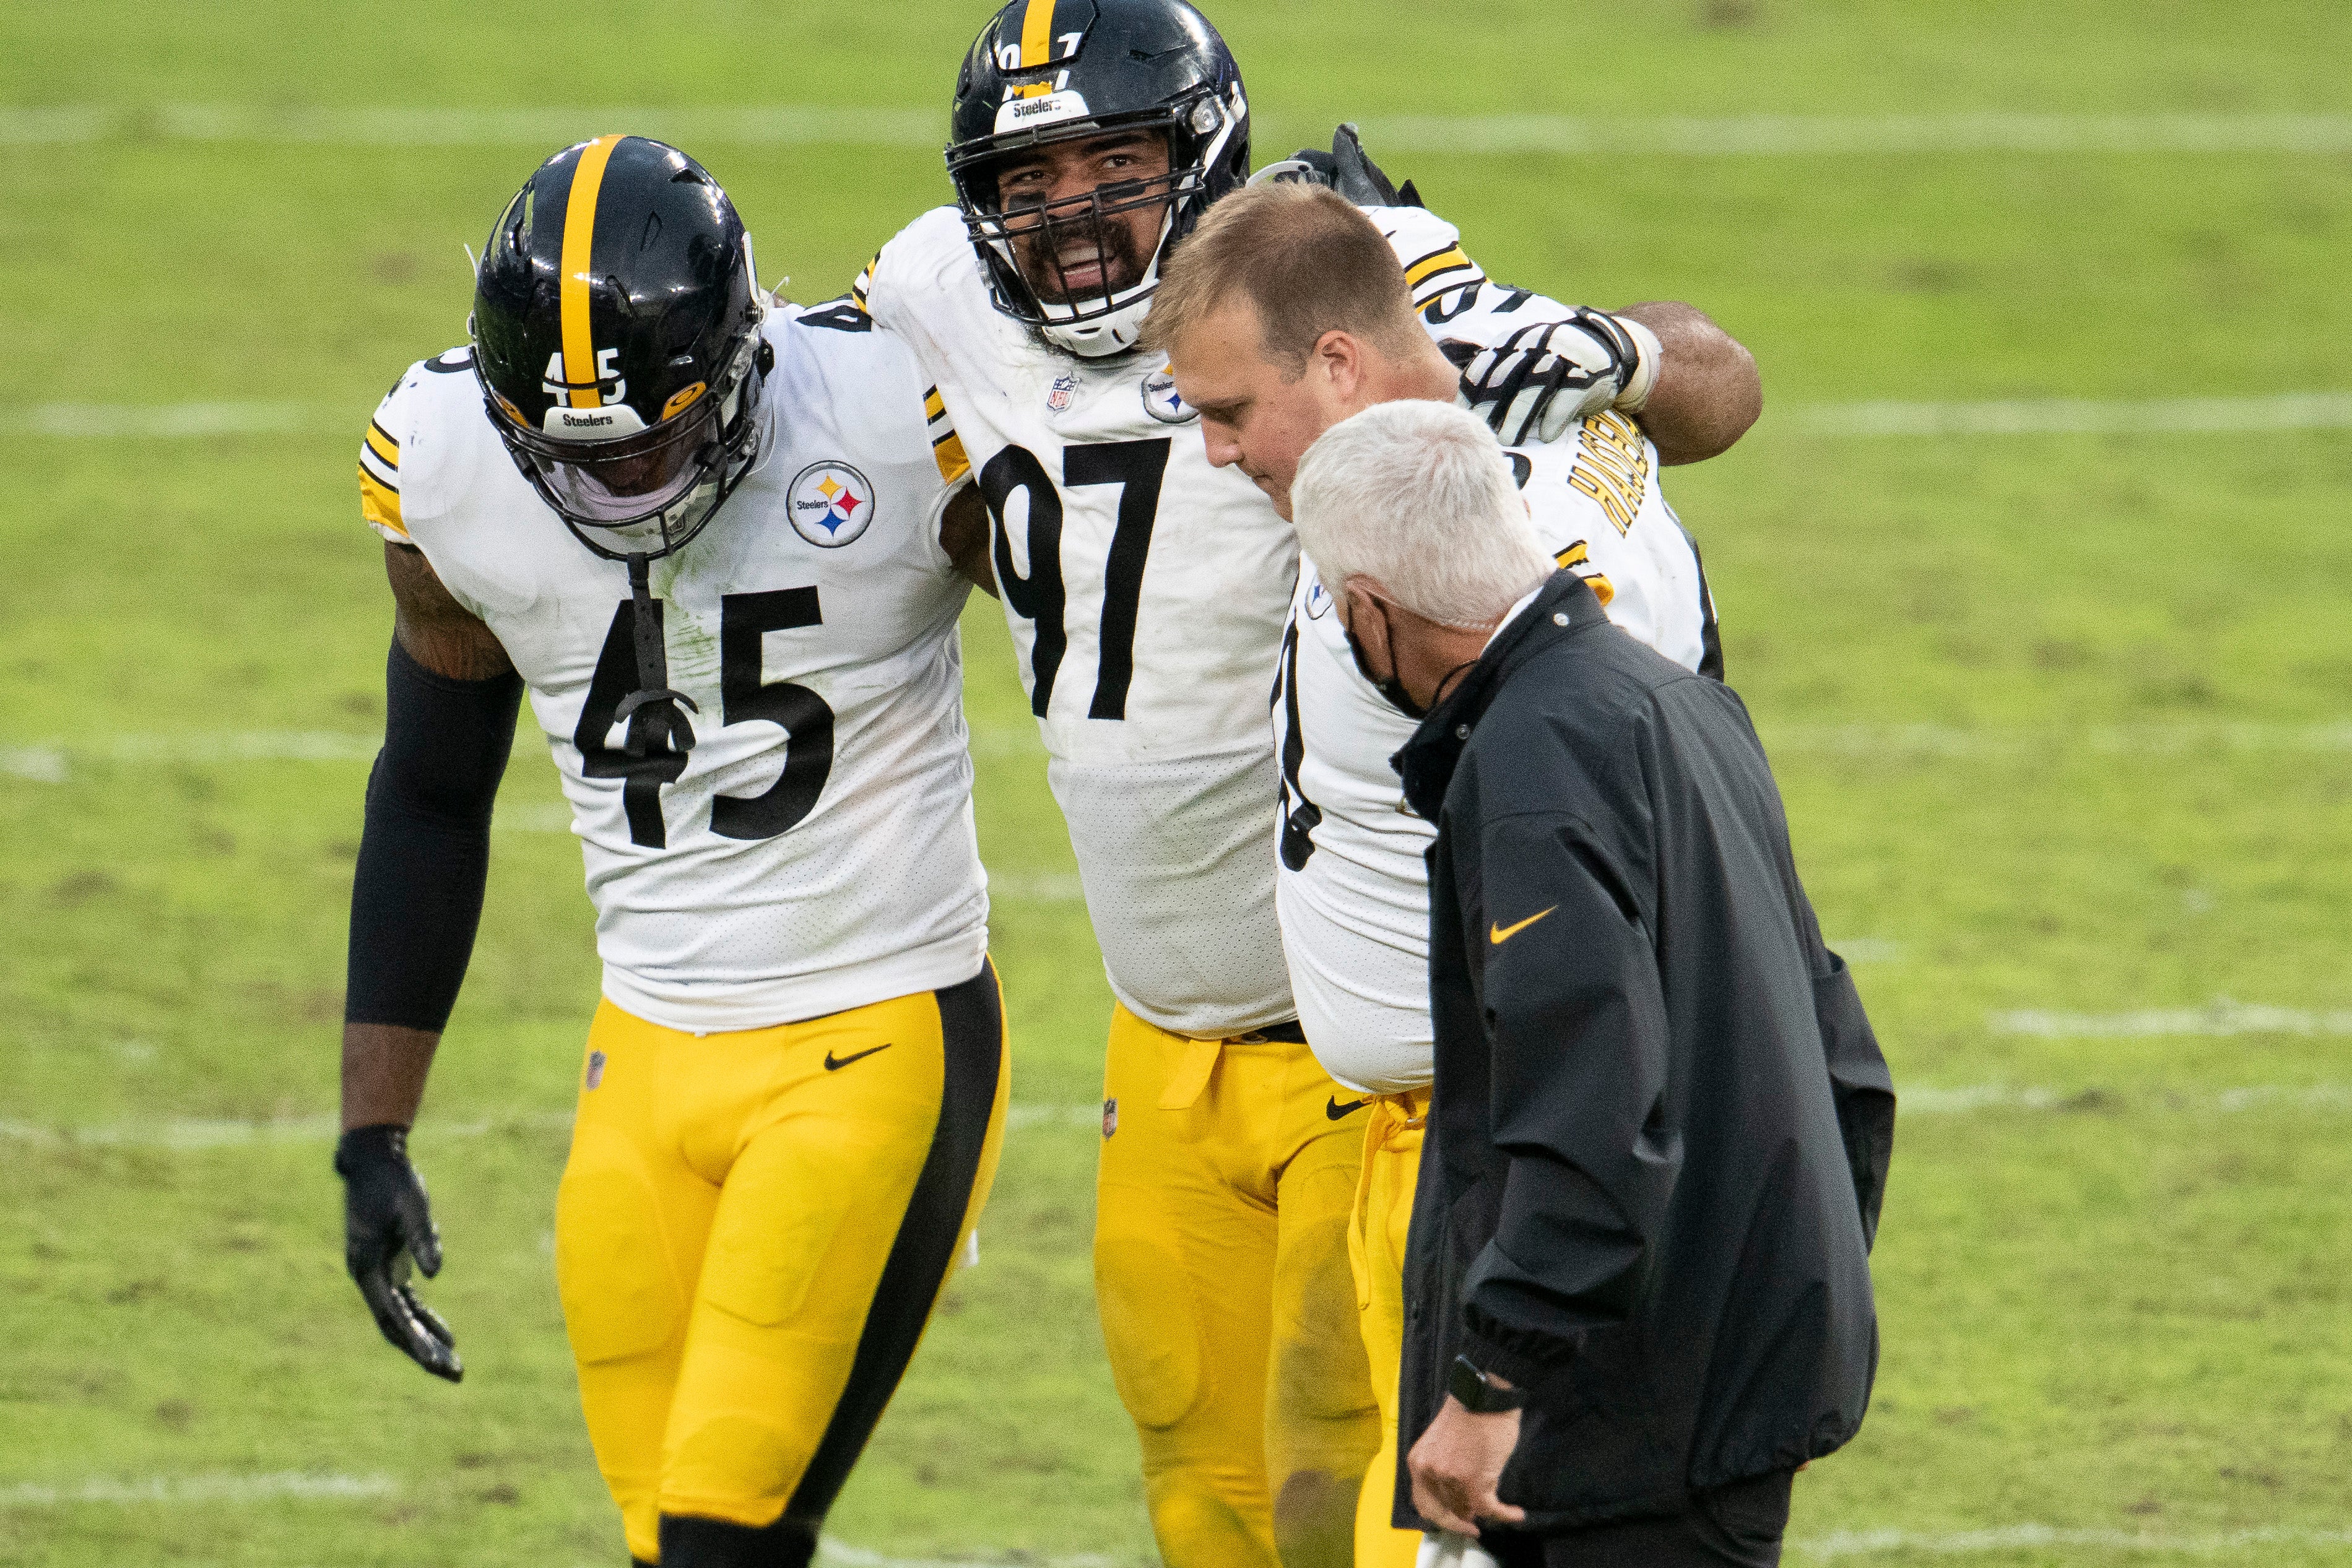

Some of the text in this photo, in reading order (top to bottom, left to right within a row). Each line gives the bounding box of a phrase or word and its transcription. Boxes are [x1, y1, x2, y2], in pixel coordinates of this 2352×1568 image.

[542, 348, 627, 406] 45
[1148, 381, 1174, 392] Steeler
[562, 413, 613, 427] Steelers
[796, 500, 829, 510] Steelers
[979, 437, 1171, 720] 97
[573, 586, 835, 849] 45
